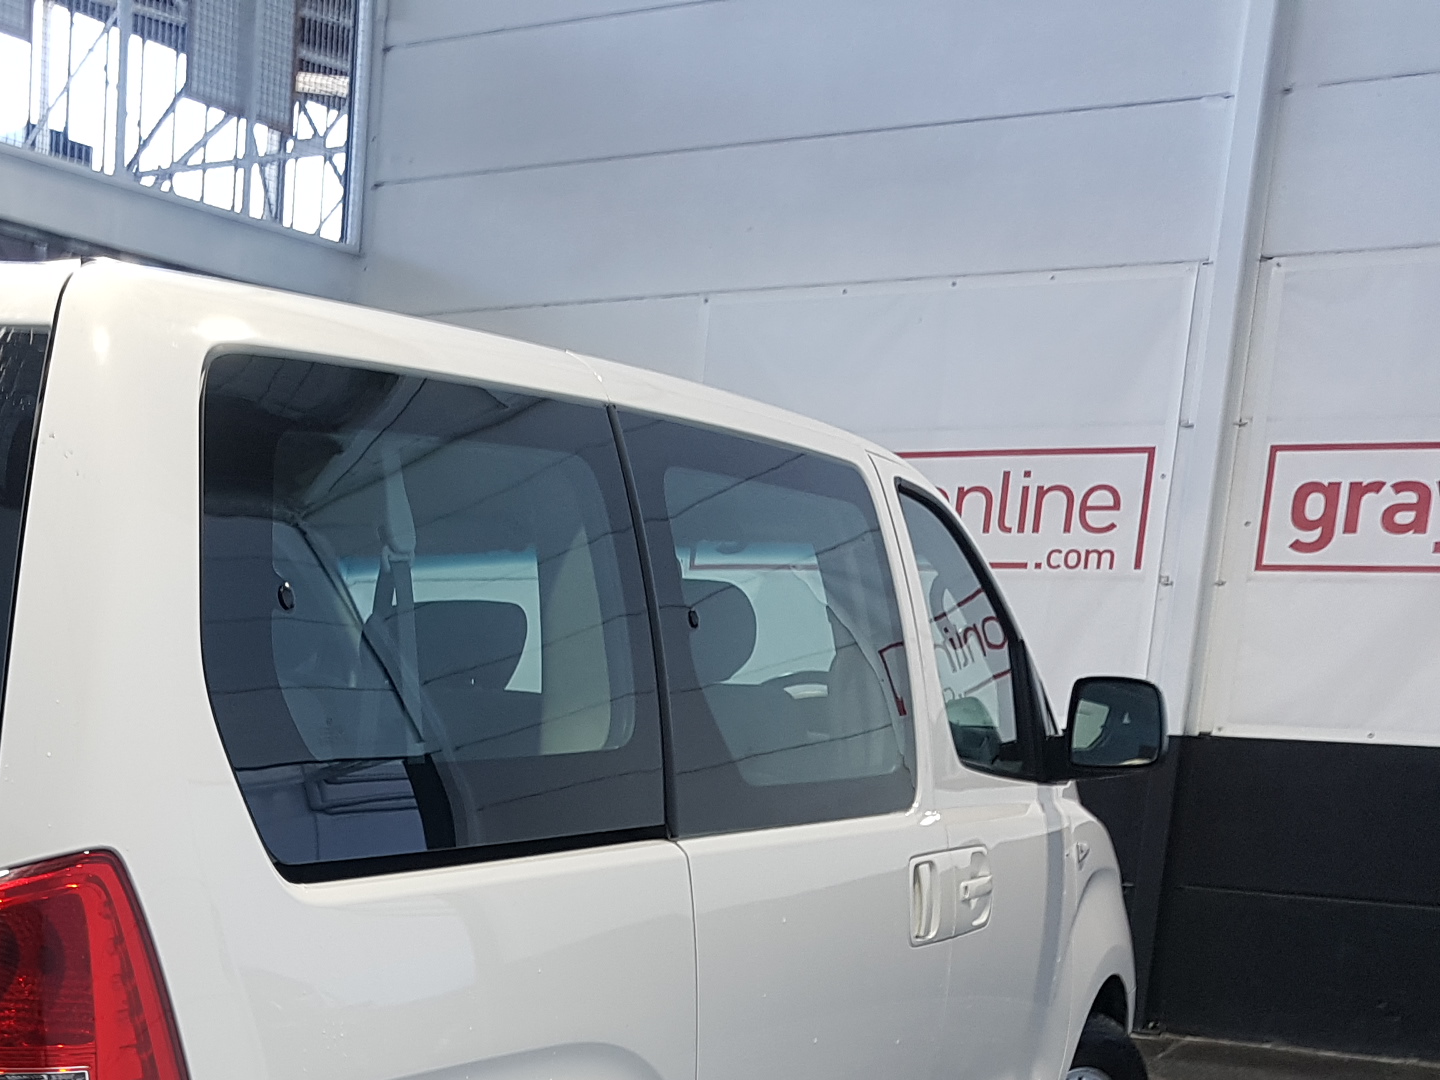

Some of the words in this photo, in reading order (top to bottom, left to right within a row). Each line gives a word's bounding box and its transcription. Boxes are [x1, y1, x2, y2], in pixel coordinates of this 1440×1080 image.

[936, 469, 1122, 534] nline
[1288, 480, 1440, 554] gra
[1034, 548, 1116, 570] .com
